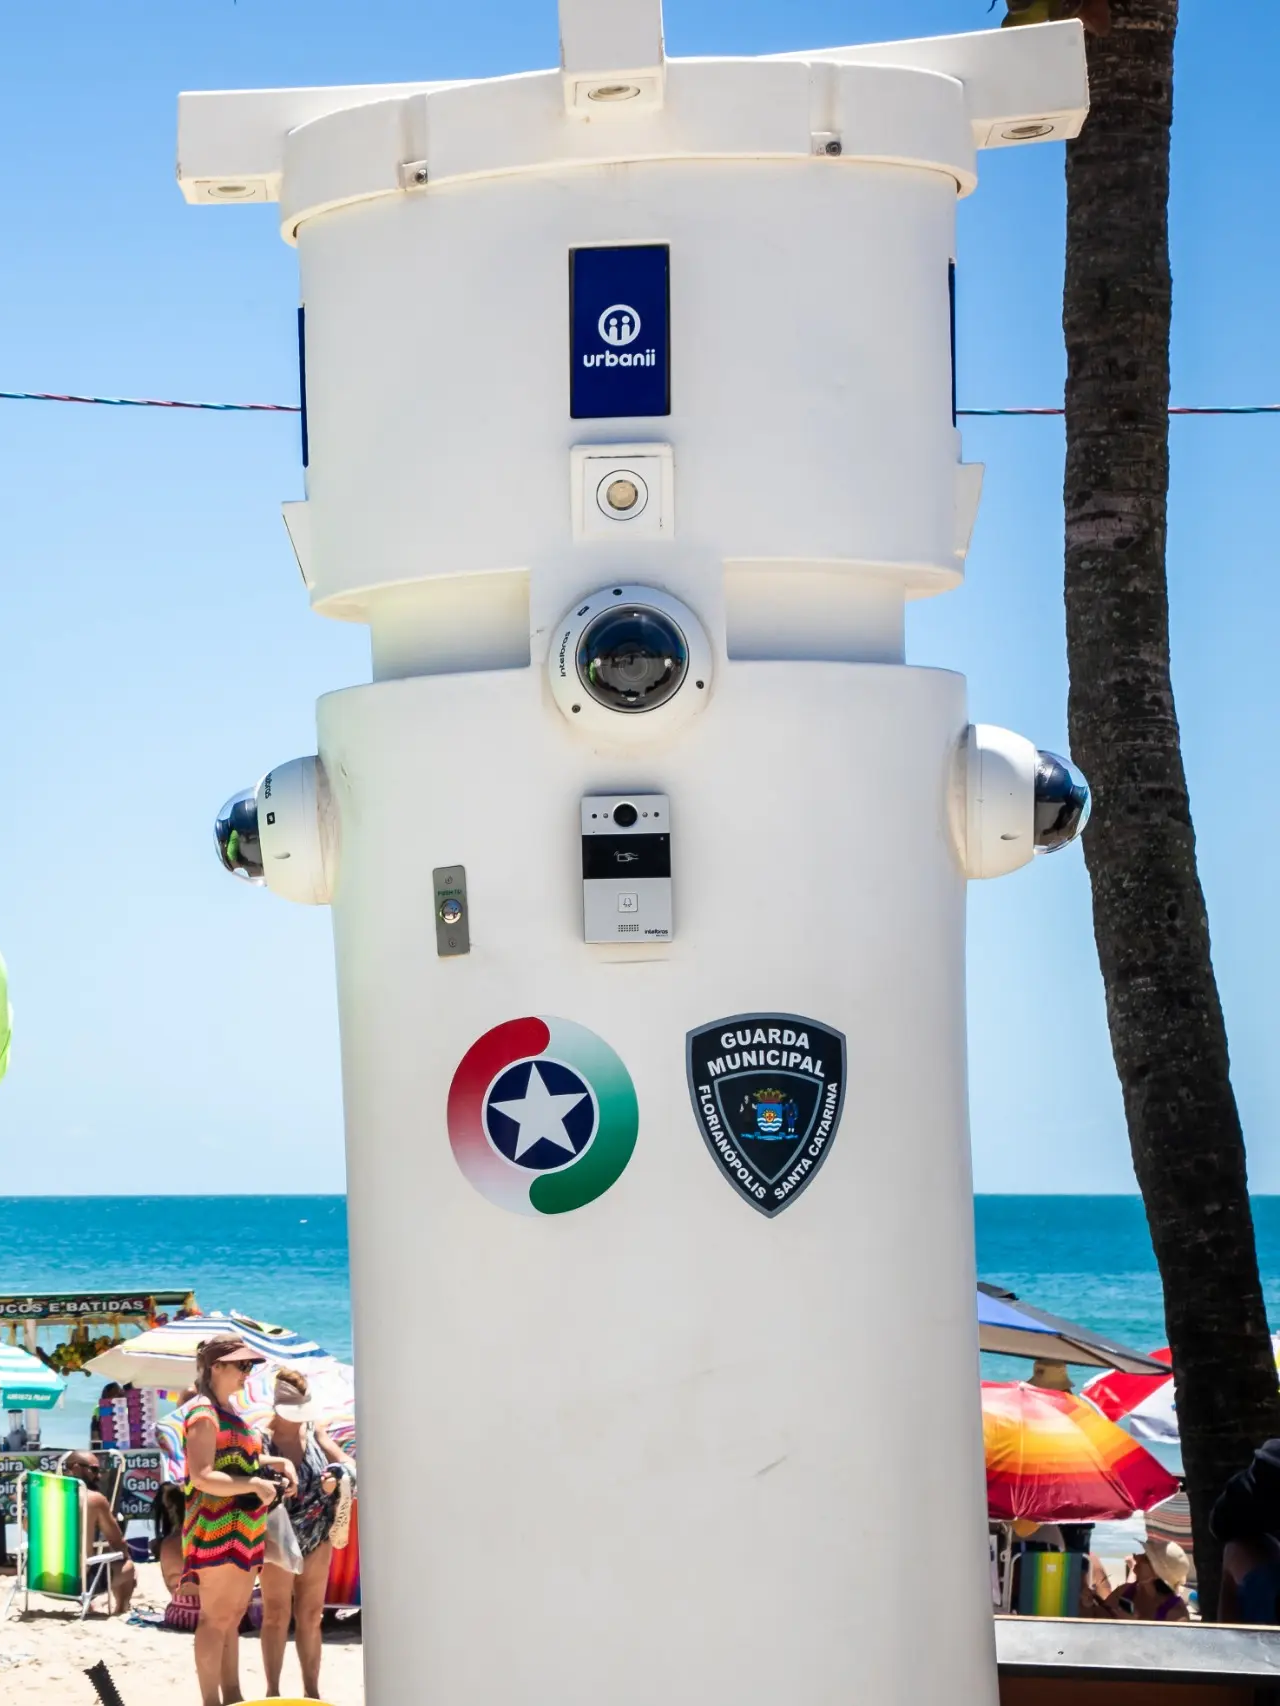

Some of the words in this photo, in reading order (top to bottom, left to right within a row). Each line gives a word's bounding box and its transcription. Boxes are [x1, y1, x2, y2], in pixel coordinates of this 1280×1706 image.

[583, 348, 656, 368] urbanii
[558, 631, 571, 677] intelbras
[720, 1028, 810, 1049] GUARDA
[707, 1049, 825, 1078] MUNICIPAL
[698, 1084, 767, 1199] FLORIANÓPOLIS
[774, 1158, 813, 1200] SANTA
[808, 1082, 838, 1157] CATARINA
[49, 1303, 60, 1312] E
[66, 1300, 144, 1312] BATIDAS
[113, 1455, 158, 1468] Futas
